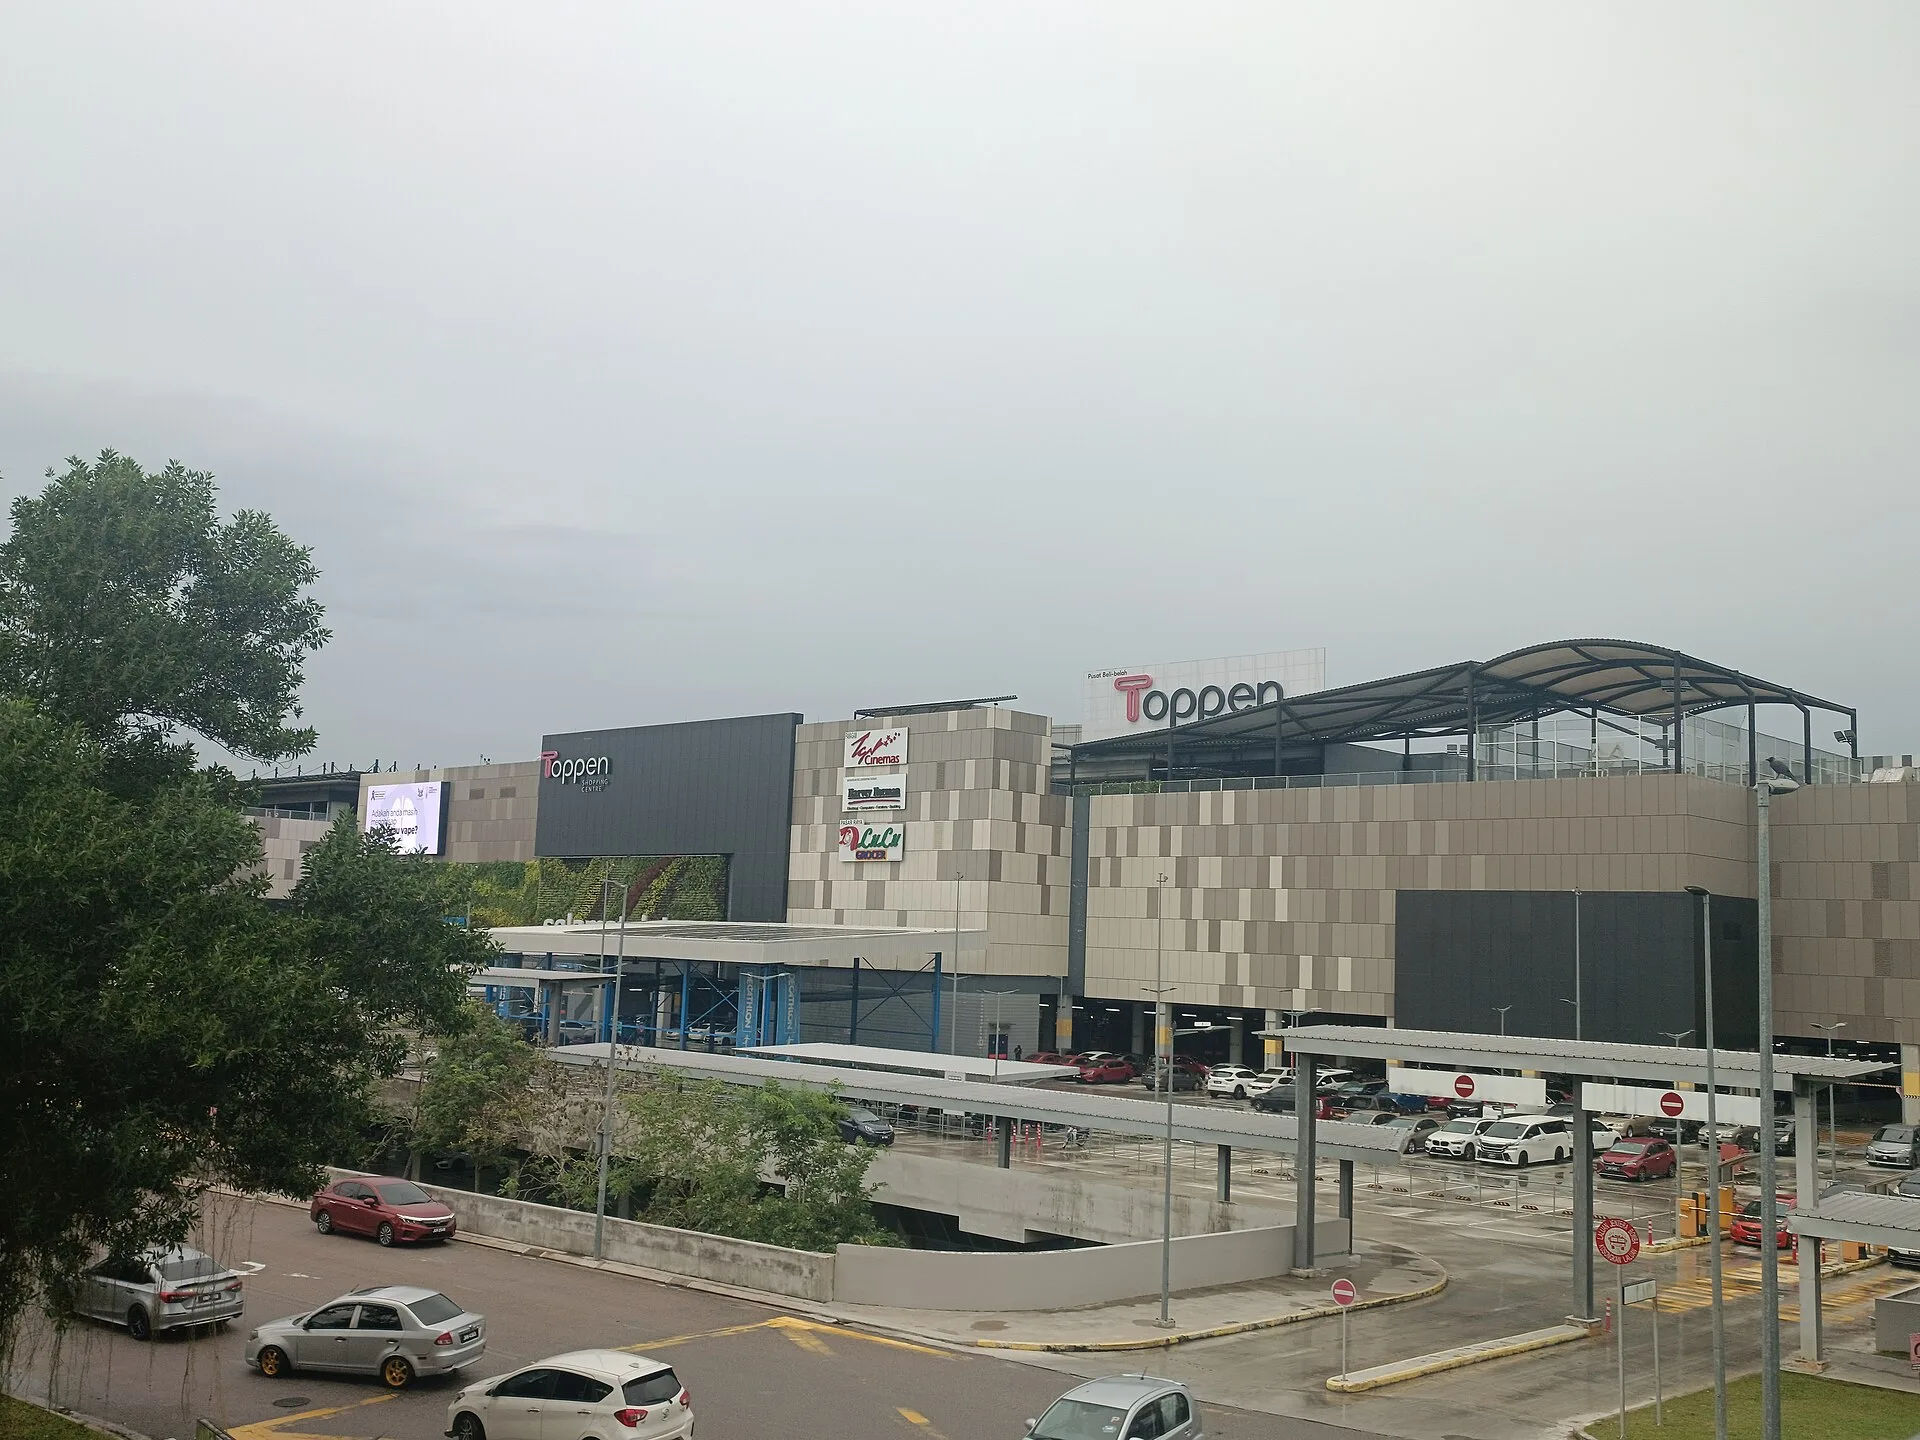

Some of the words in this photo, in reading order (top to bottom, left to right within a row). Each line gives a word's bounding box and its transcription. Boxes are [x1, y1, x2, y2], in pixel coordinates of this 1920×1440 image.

[1114, 674, 1284, 727] Toppen
[864, 755, 900, 765] Cinemas
[541, 750, 609, 785] Toppen
[581, 778, 609, 786] SHOPPING
[581, 785, 602, 793] CENTRE
[401, 825, 418, 836] vape?
